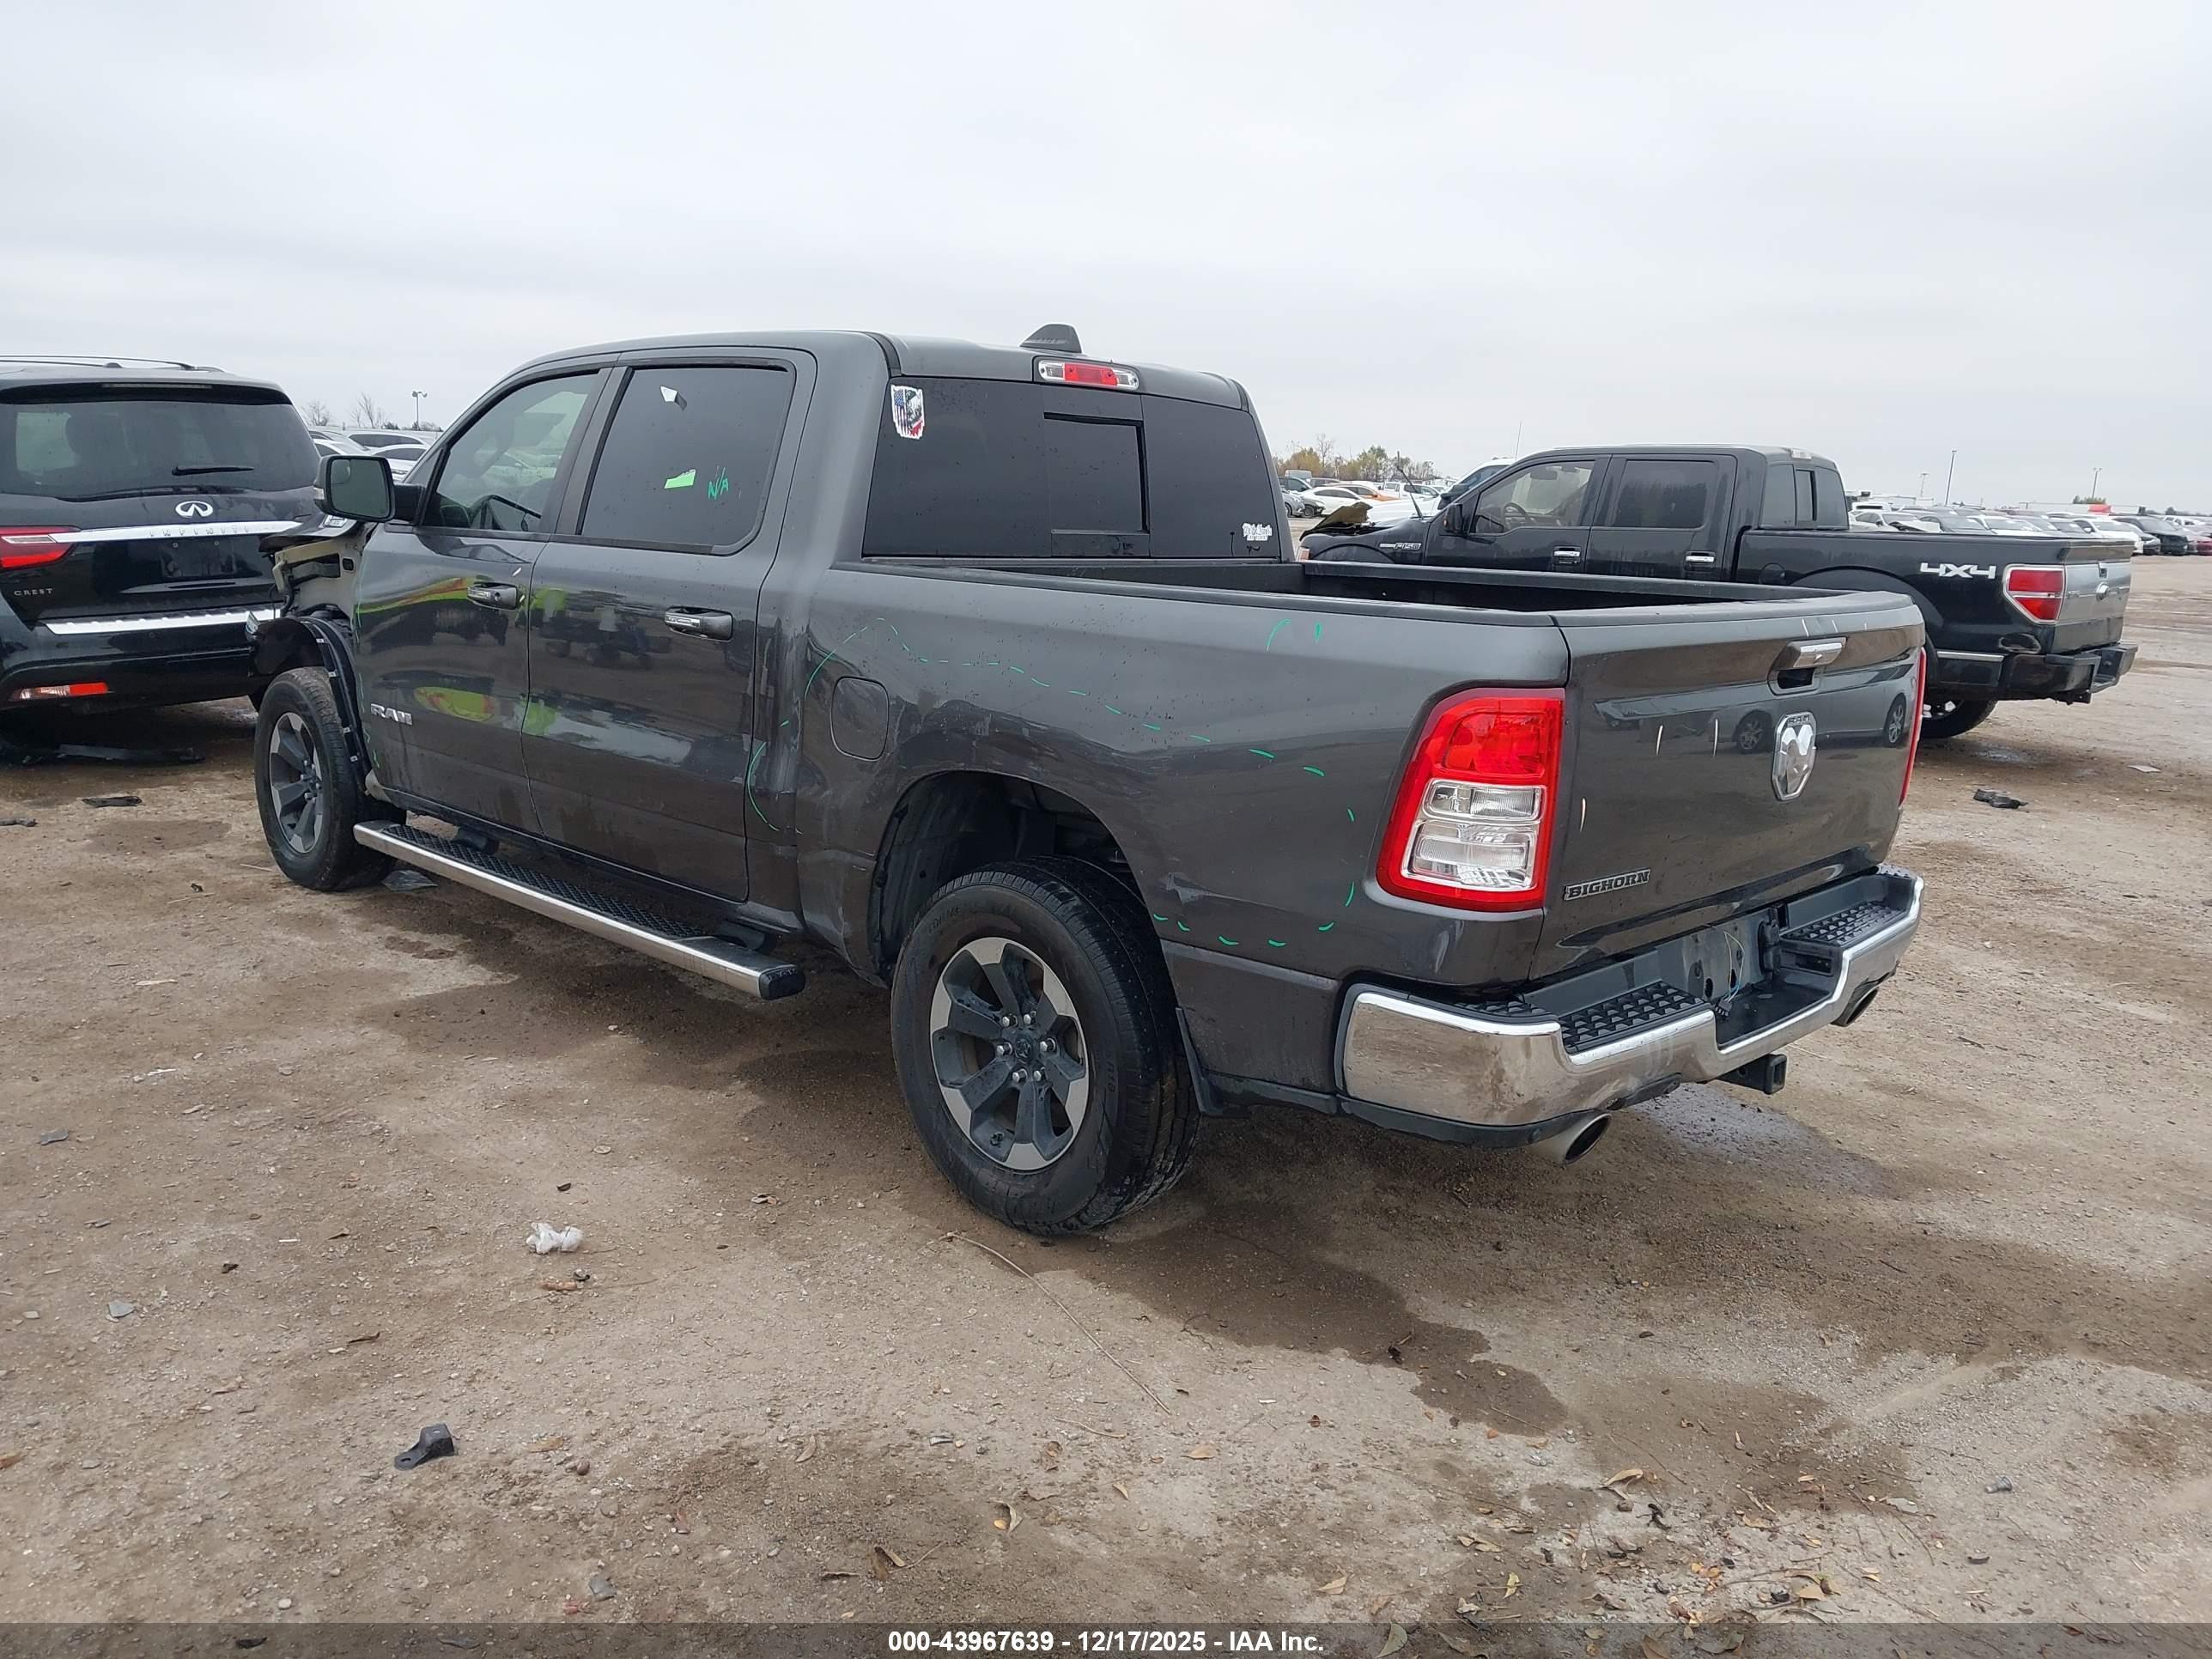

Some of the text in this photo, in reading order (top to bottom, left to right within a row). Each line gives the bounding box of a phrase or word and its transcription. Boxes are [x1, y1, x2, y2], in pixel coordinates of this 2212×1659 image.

[708, 465, 729, 500] N/A
[13, 587, 53, 596] CREST
[370, 702, 413, 726] RAM
[1787, 714, 1811, 727] RAM
[1564, 869, 1651, 901] BIGHORN
